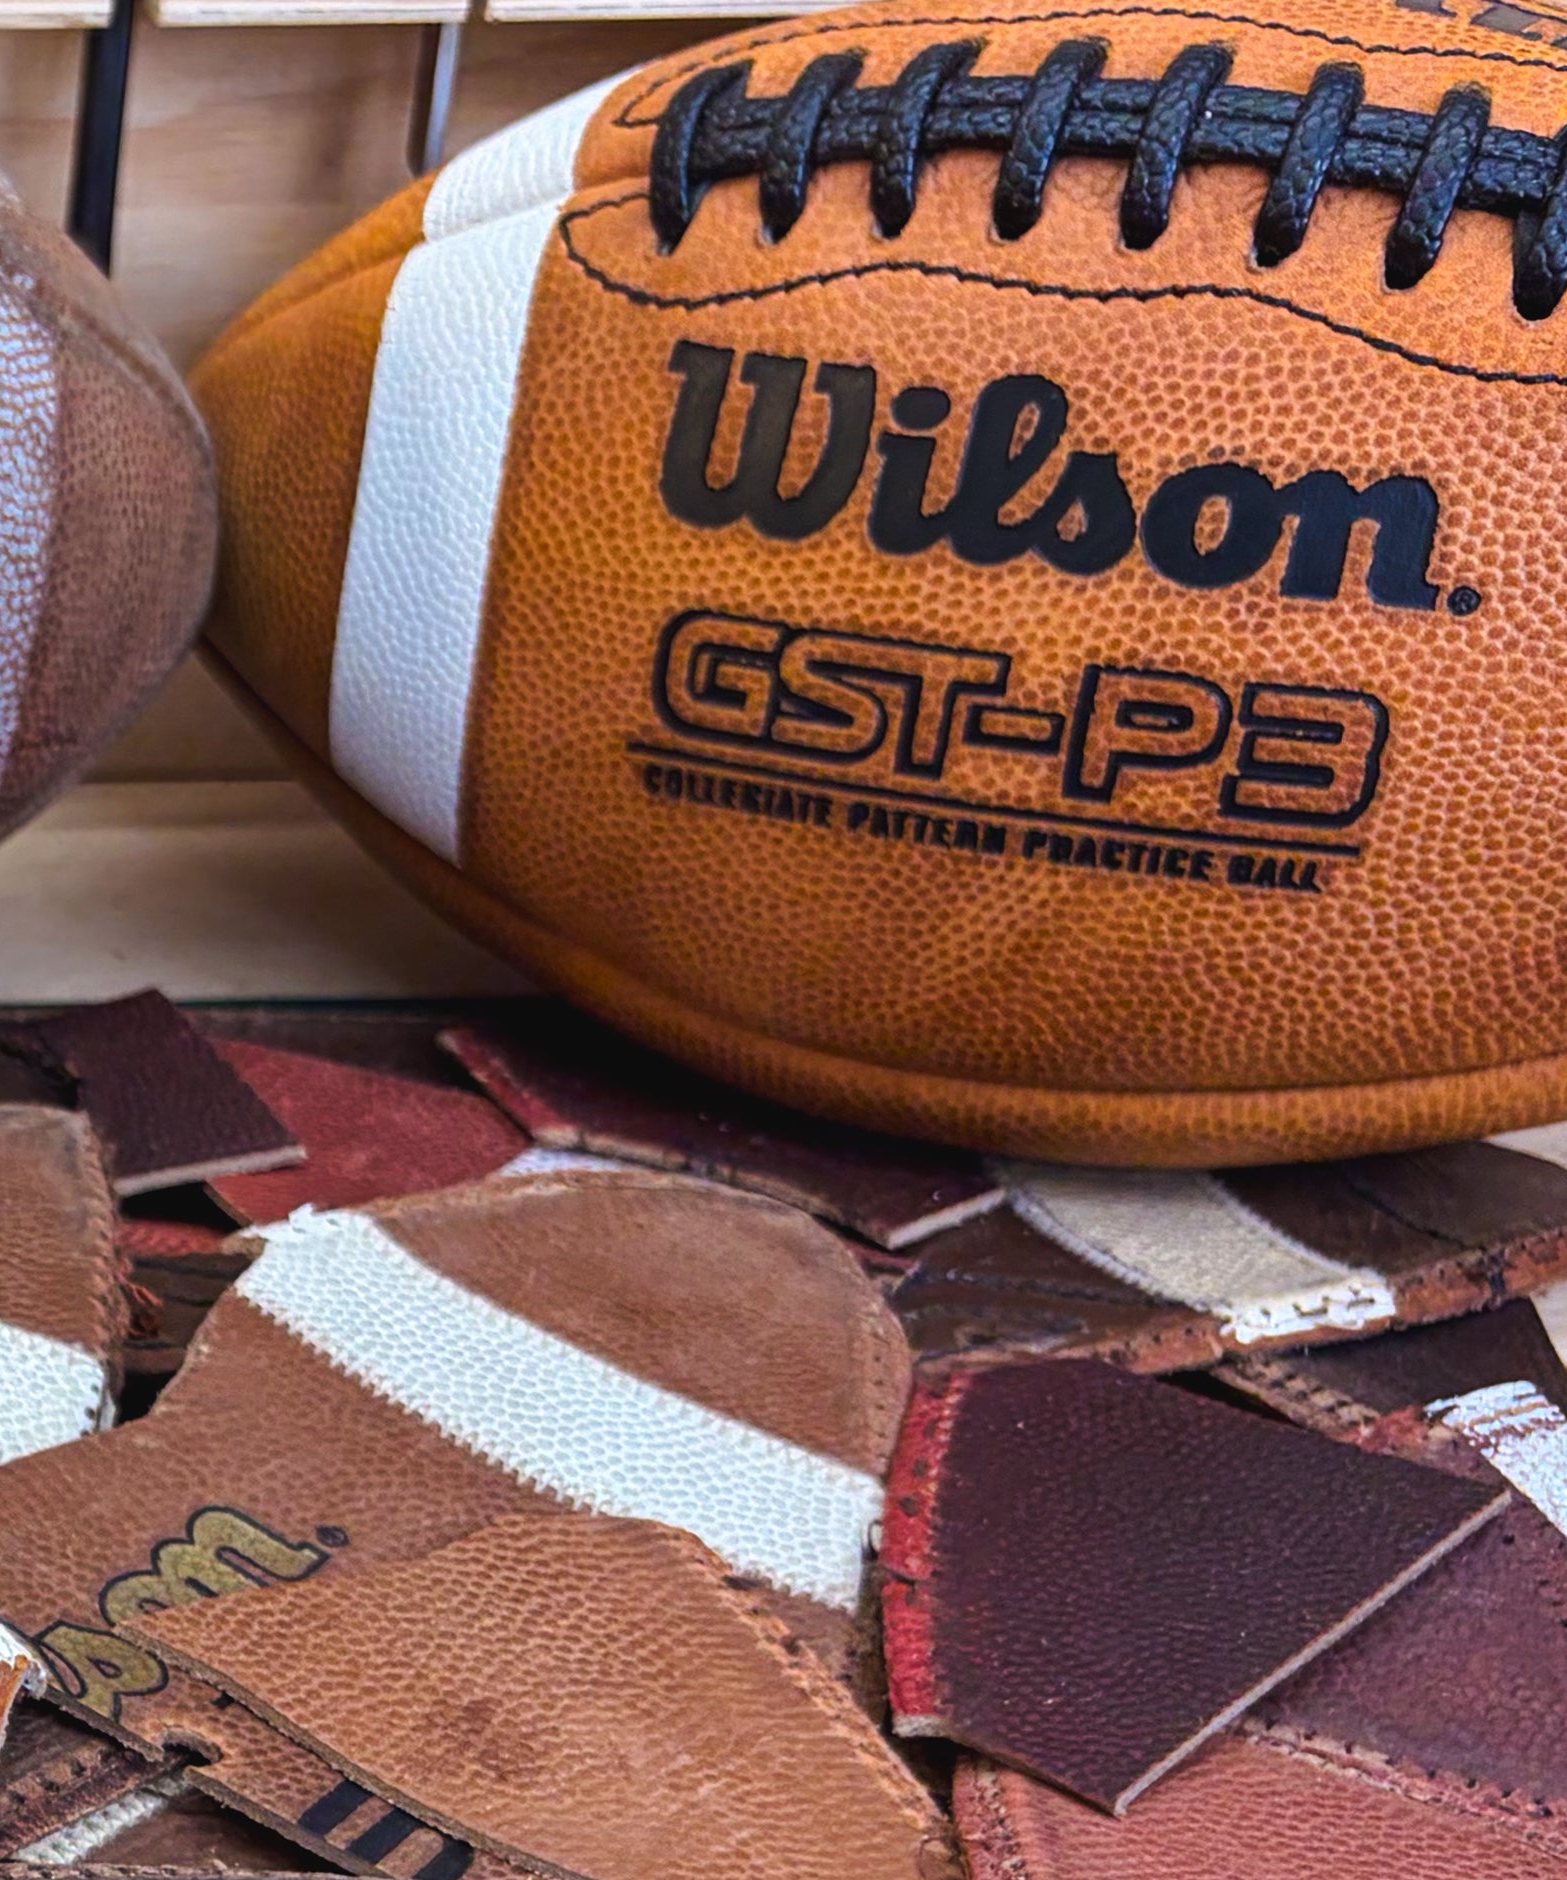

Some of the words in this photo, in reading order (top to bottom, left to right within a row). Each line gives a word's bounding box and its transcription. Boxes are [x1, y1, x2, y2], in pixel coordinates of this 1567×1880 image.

[660, 338, 1441, 613] Wilson
[641, 762, 834, 829] COLLEGIATE
[846, 799, 1007, 856] PATTERN
[1020, 828, 1214, 883] PRACTICE
[1226, 853, 1322, 894] BALL
[652, 609, 1390, 829] GST-P3
